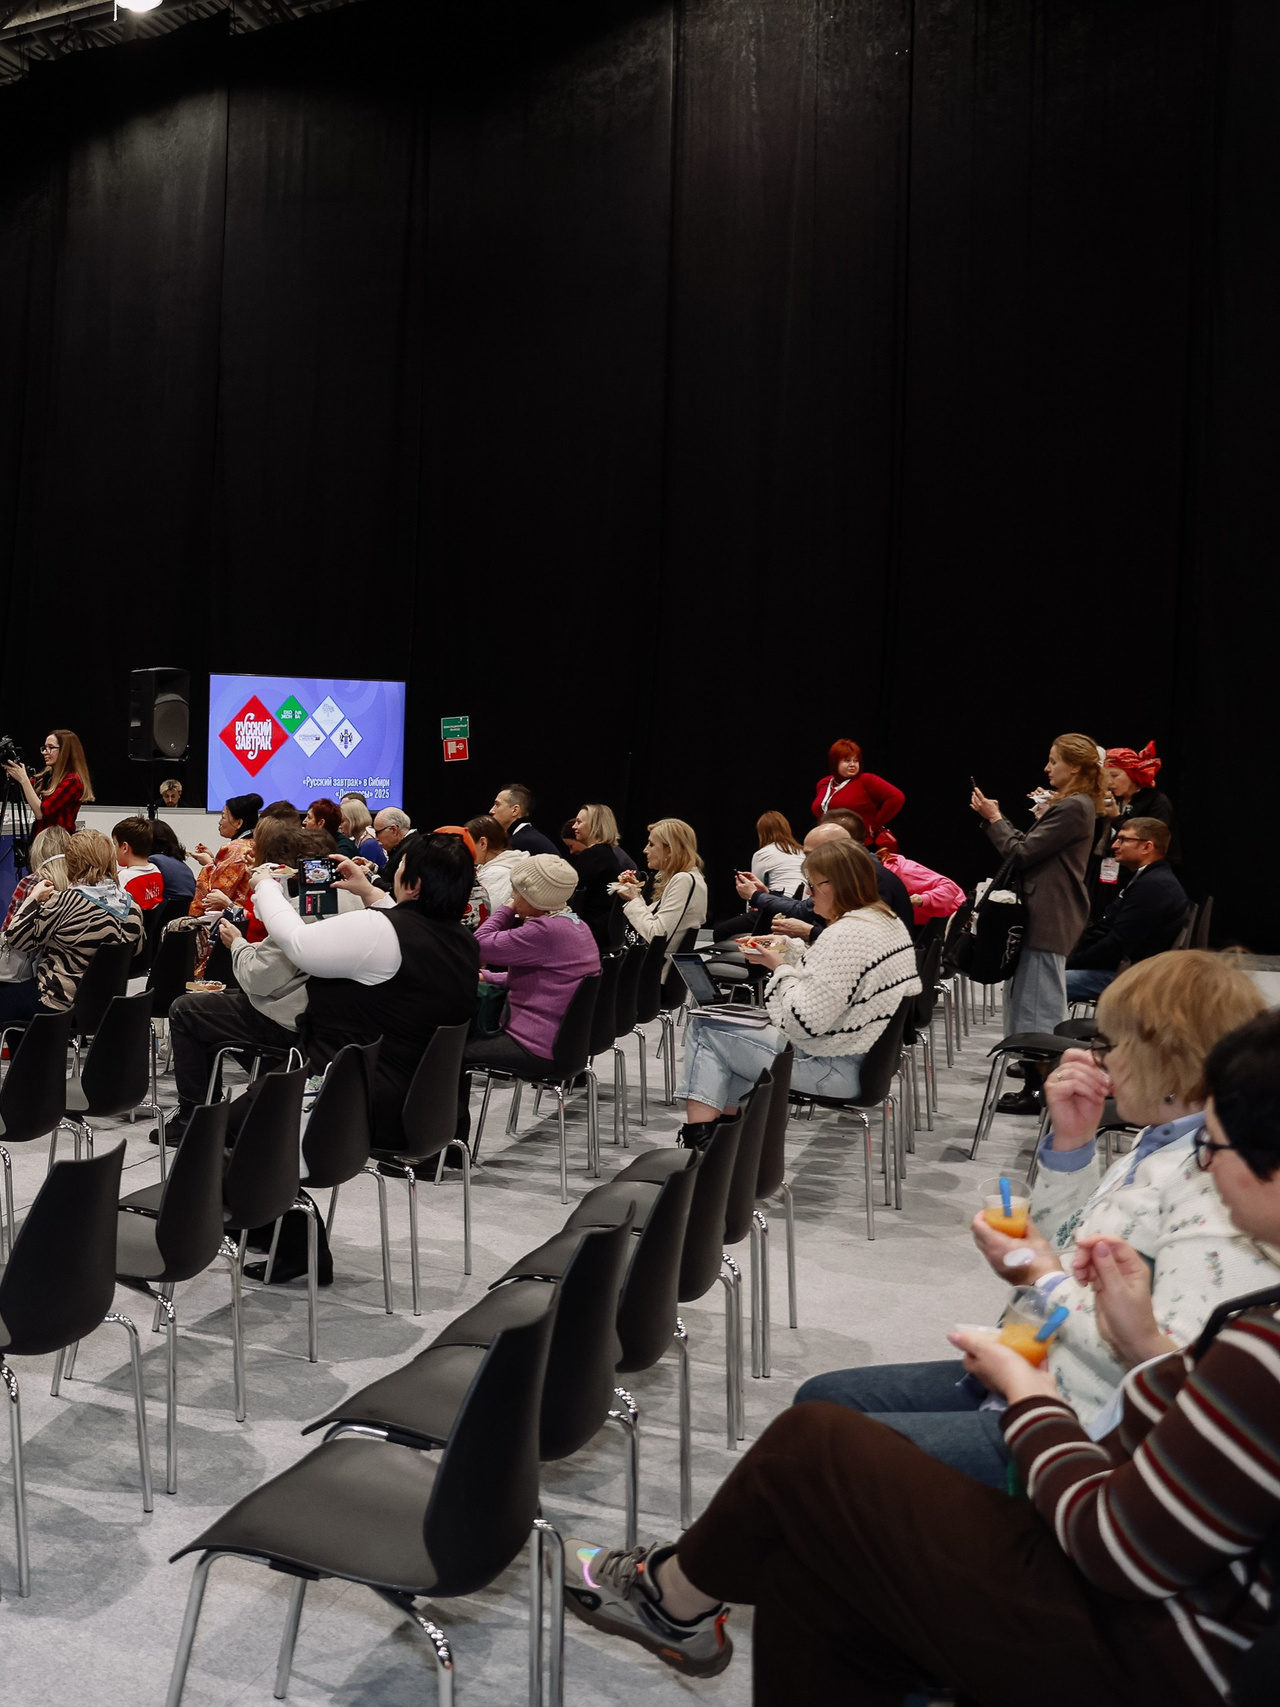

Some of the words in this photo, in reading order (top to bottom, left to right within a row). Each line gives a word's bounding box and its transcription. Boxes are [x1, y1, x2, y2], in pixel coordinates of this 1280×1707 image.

[235, 712, 272, 736] РУССКИЙ
[235, 735, 272, 760] ЗАВТРАК
[302, 776, 332, 788] «Русский
[333, 778, 362, 788] завтрак»
[363, 779, 367, 787] в
[368, 776, 390, 788] Сибири
[374, 788, 390, 799] 2025
